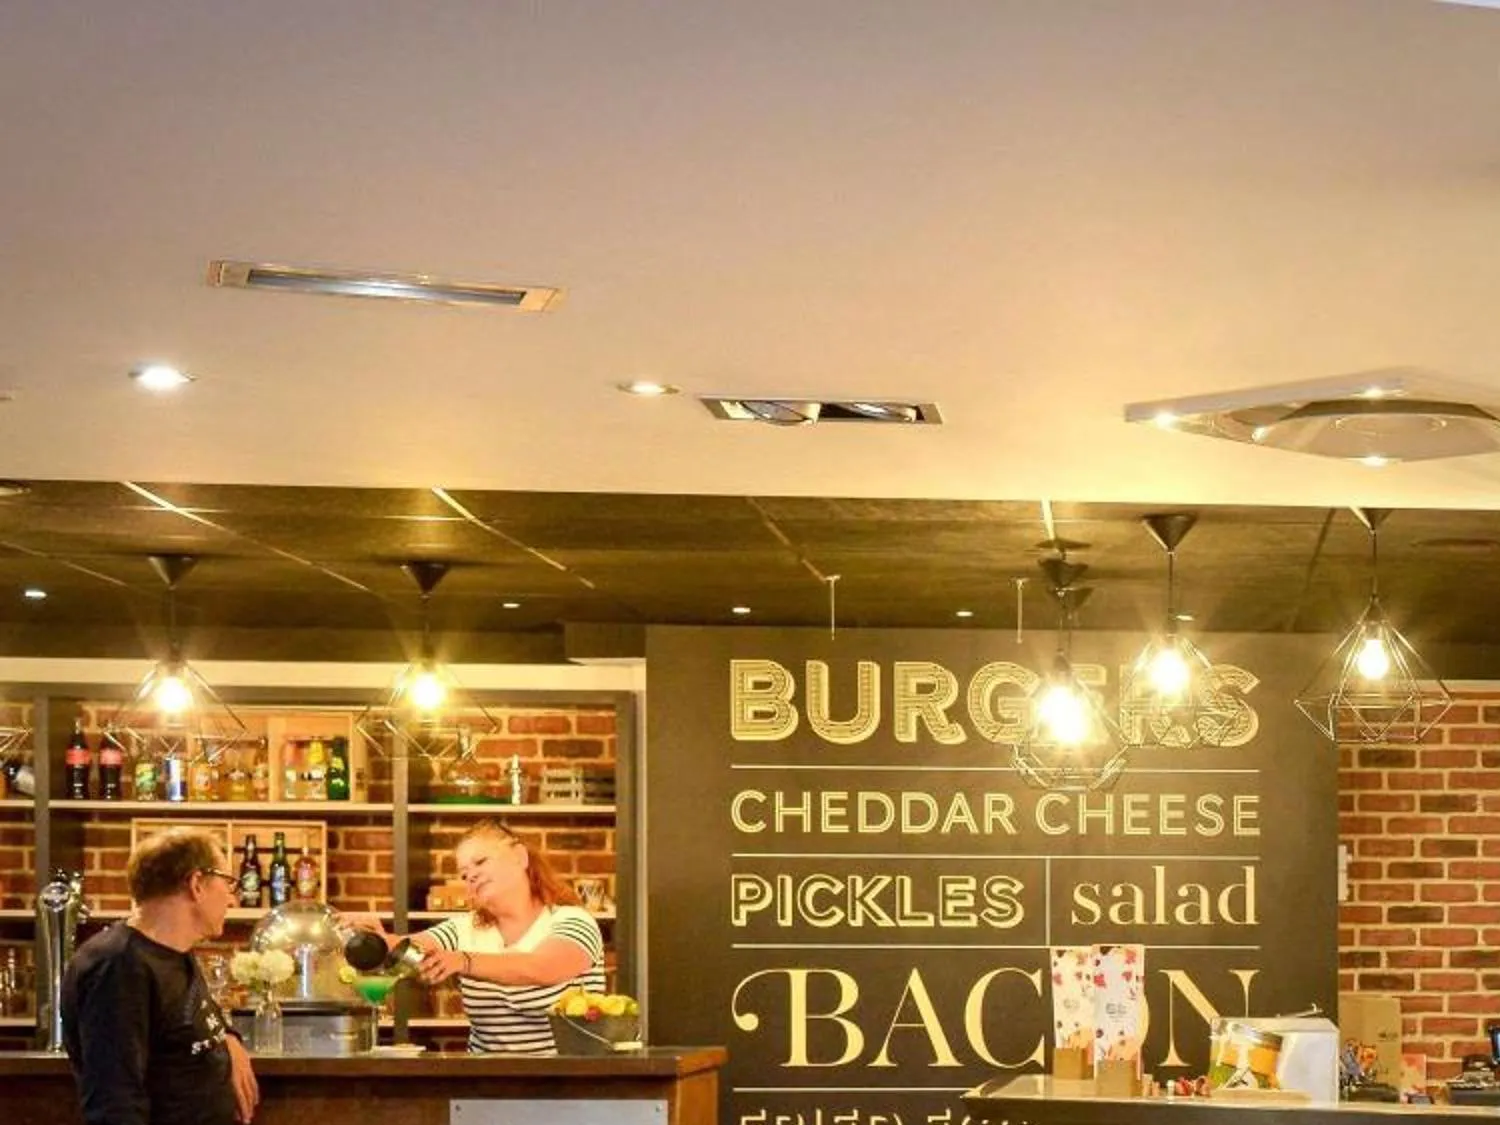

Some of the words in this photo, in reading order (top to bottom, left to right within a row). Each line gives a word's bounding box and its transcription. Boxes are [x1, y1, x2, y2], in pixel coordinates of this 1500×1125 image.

[730, 789, 1016, 835] CHEDDAR
[1035, 791, 1260, 837] CHEESE
[730, 873, 1026, 928] PICKLES
[1070, 865, 1260, 926] salad
[731, 967, 1261, 1069] BACN
